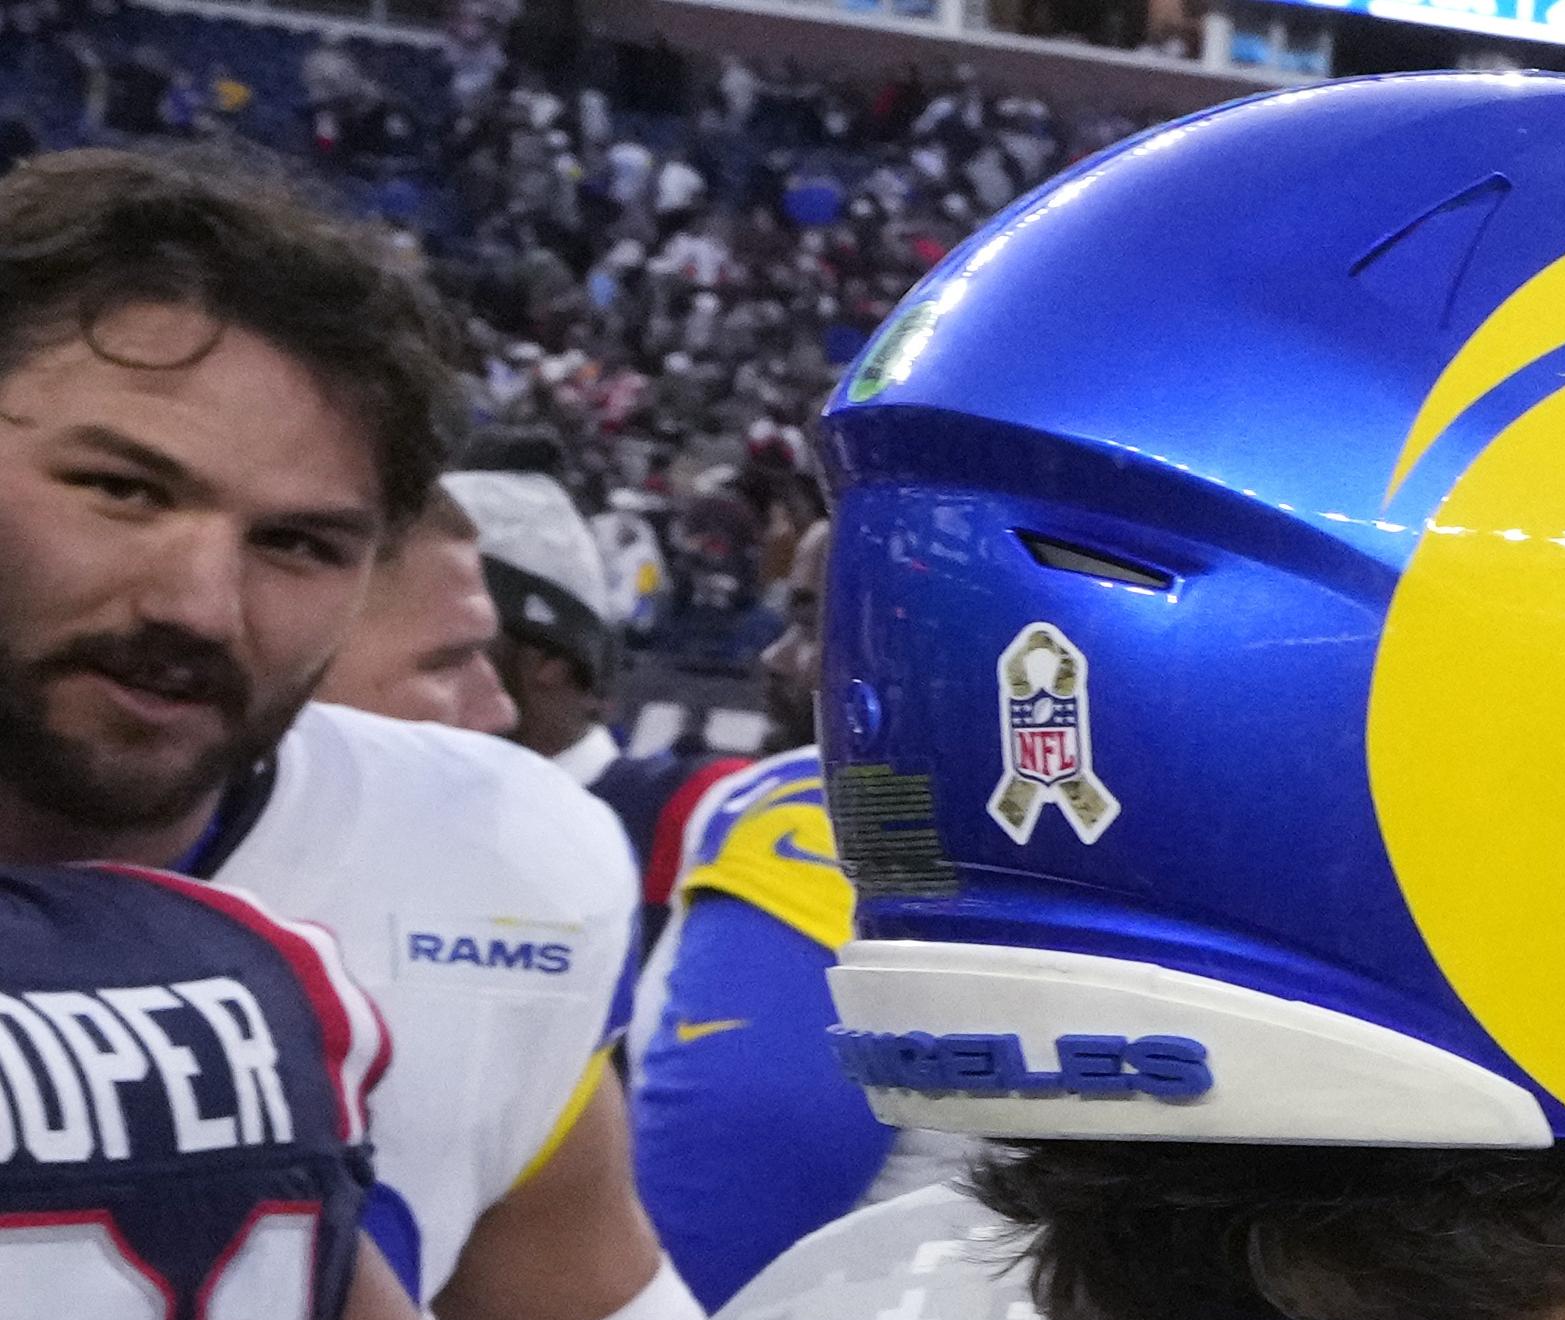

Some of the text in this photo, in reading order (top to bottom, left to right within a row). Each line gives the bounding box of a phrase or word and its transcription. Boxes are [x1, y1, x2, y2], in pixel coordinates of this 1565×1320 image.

[1018, 731, 1077, 776] NFL
[409, 932, 573, 974] RAMS
[0, 976, 294, 1164] OPER
